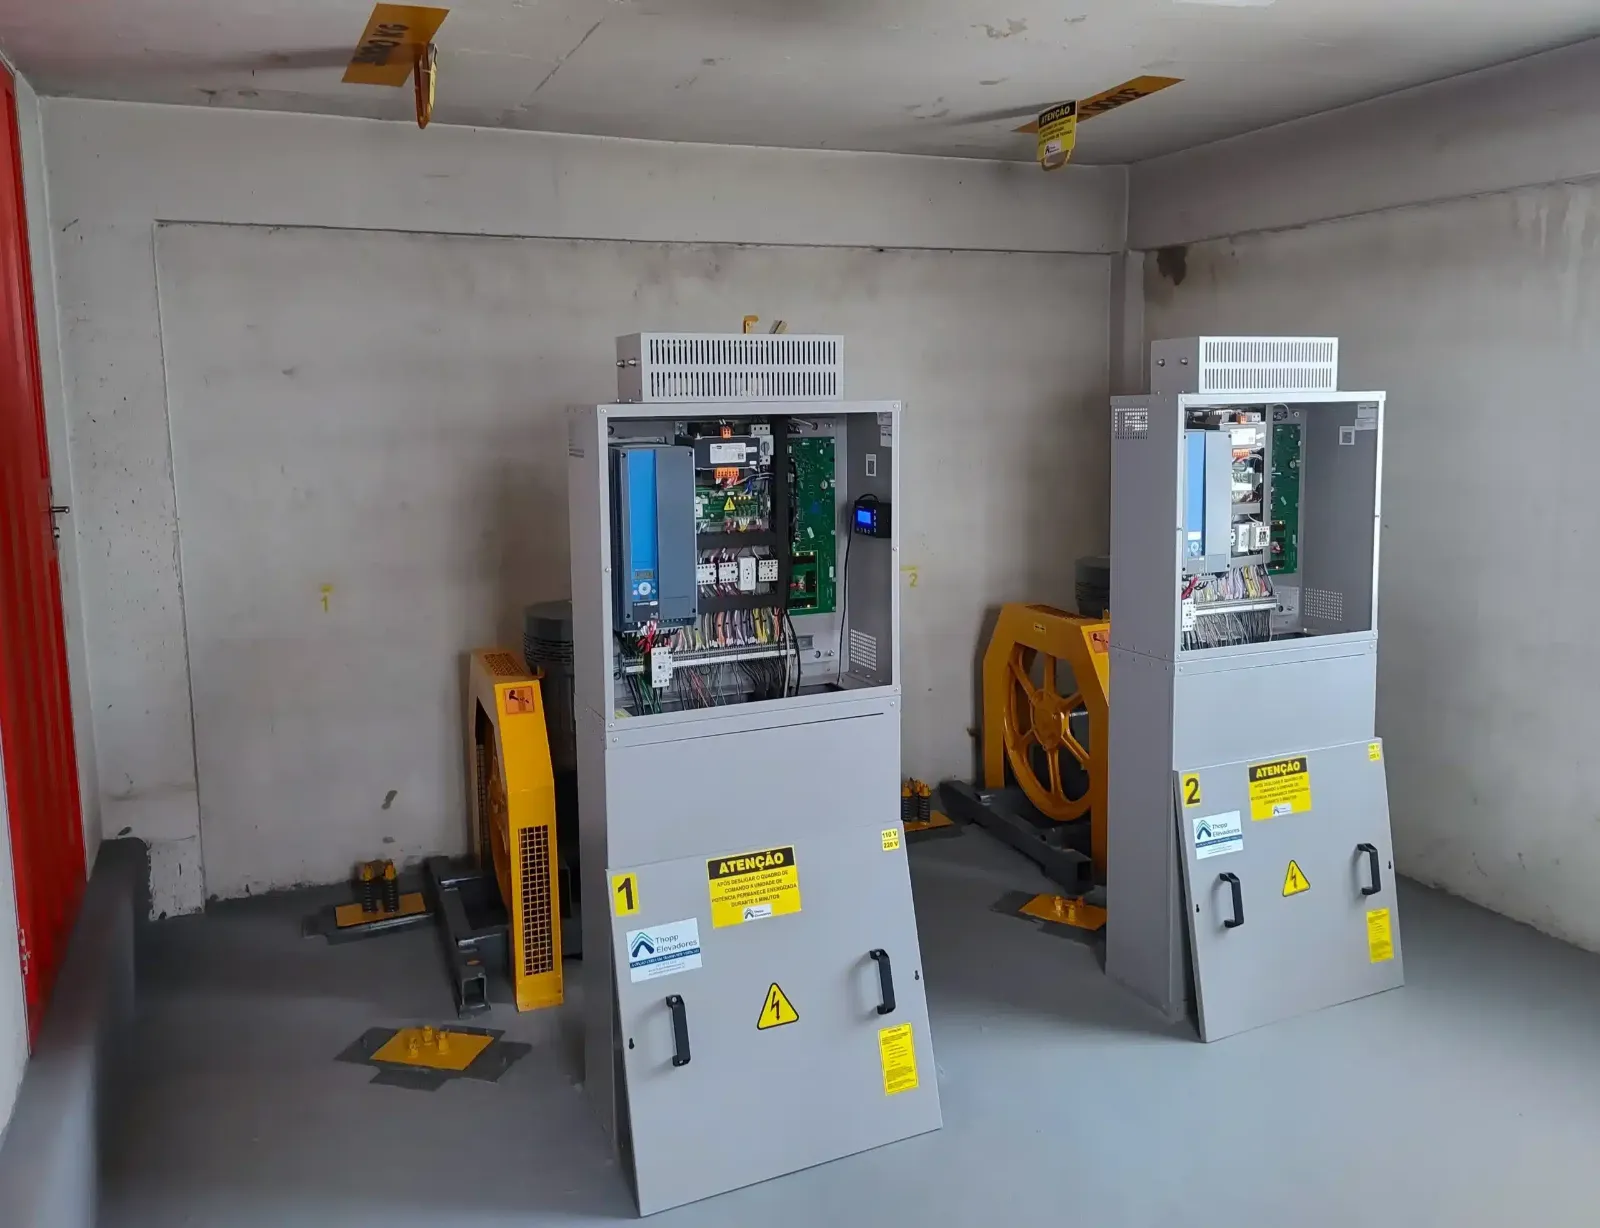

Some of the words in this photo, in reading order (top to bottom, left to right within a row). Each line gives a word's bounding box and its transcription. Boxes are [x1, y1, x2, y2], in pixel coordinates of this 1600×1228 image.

[1041, 105, 1070, 125] ATENÇÃO
[1256, 761, 1300, 778] ATENÇÃO
[1185, 777, 1201, 805] 2
[719, 851, 784, 874] ATENÇÃO
[760, 871, 781, 880] QUADRO
[617, 877, 634, 911] 1
[724, 883, 750, 893] COMANDO
[655, 934, 679, 944] Thopp
[656, 939, 698, 954] Elevadores
